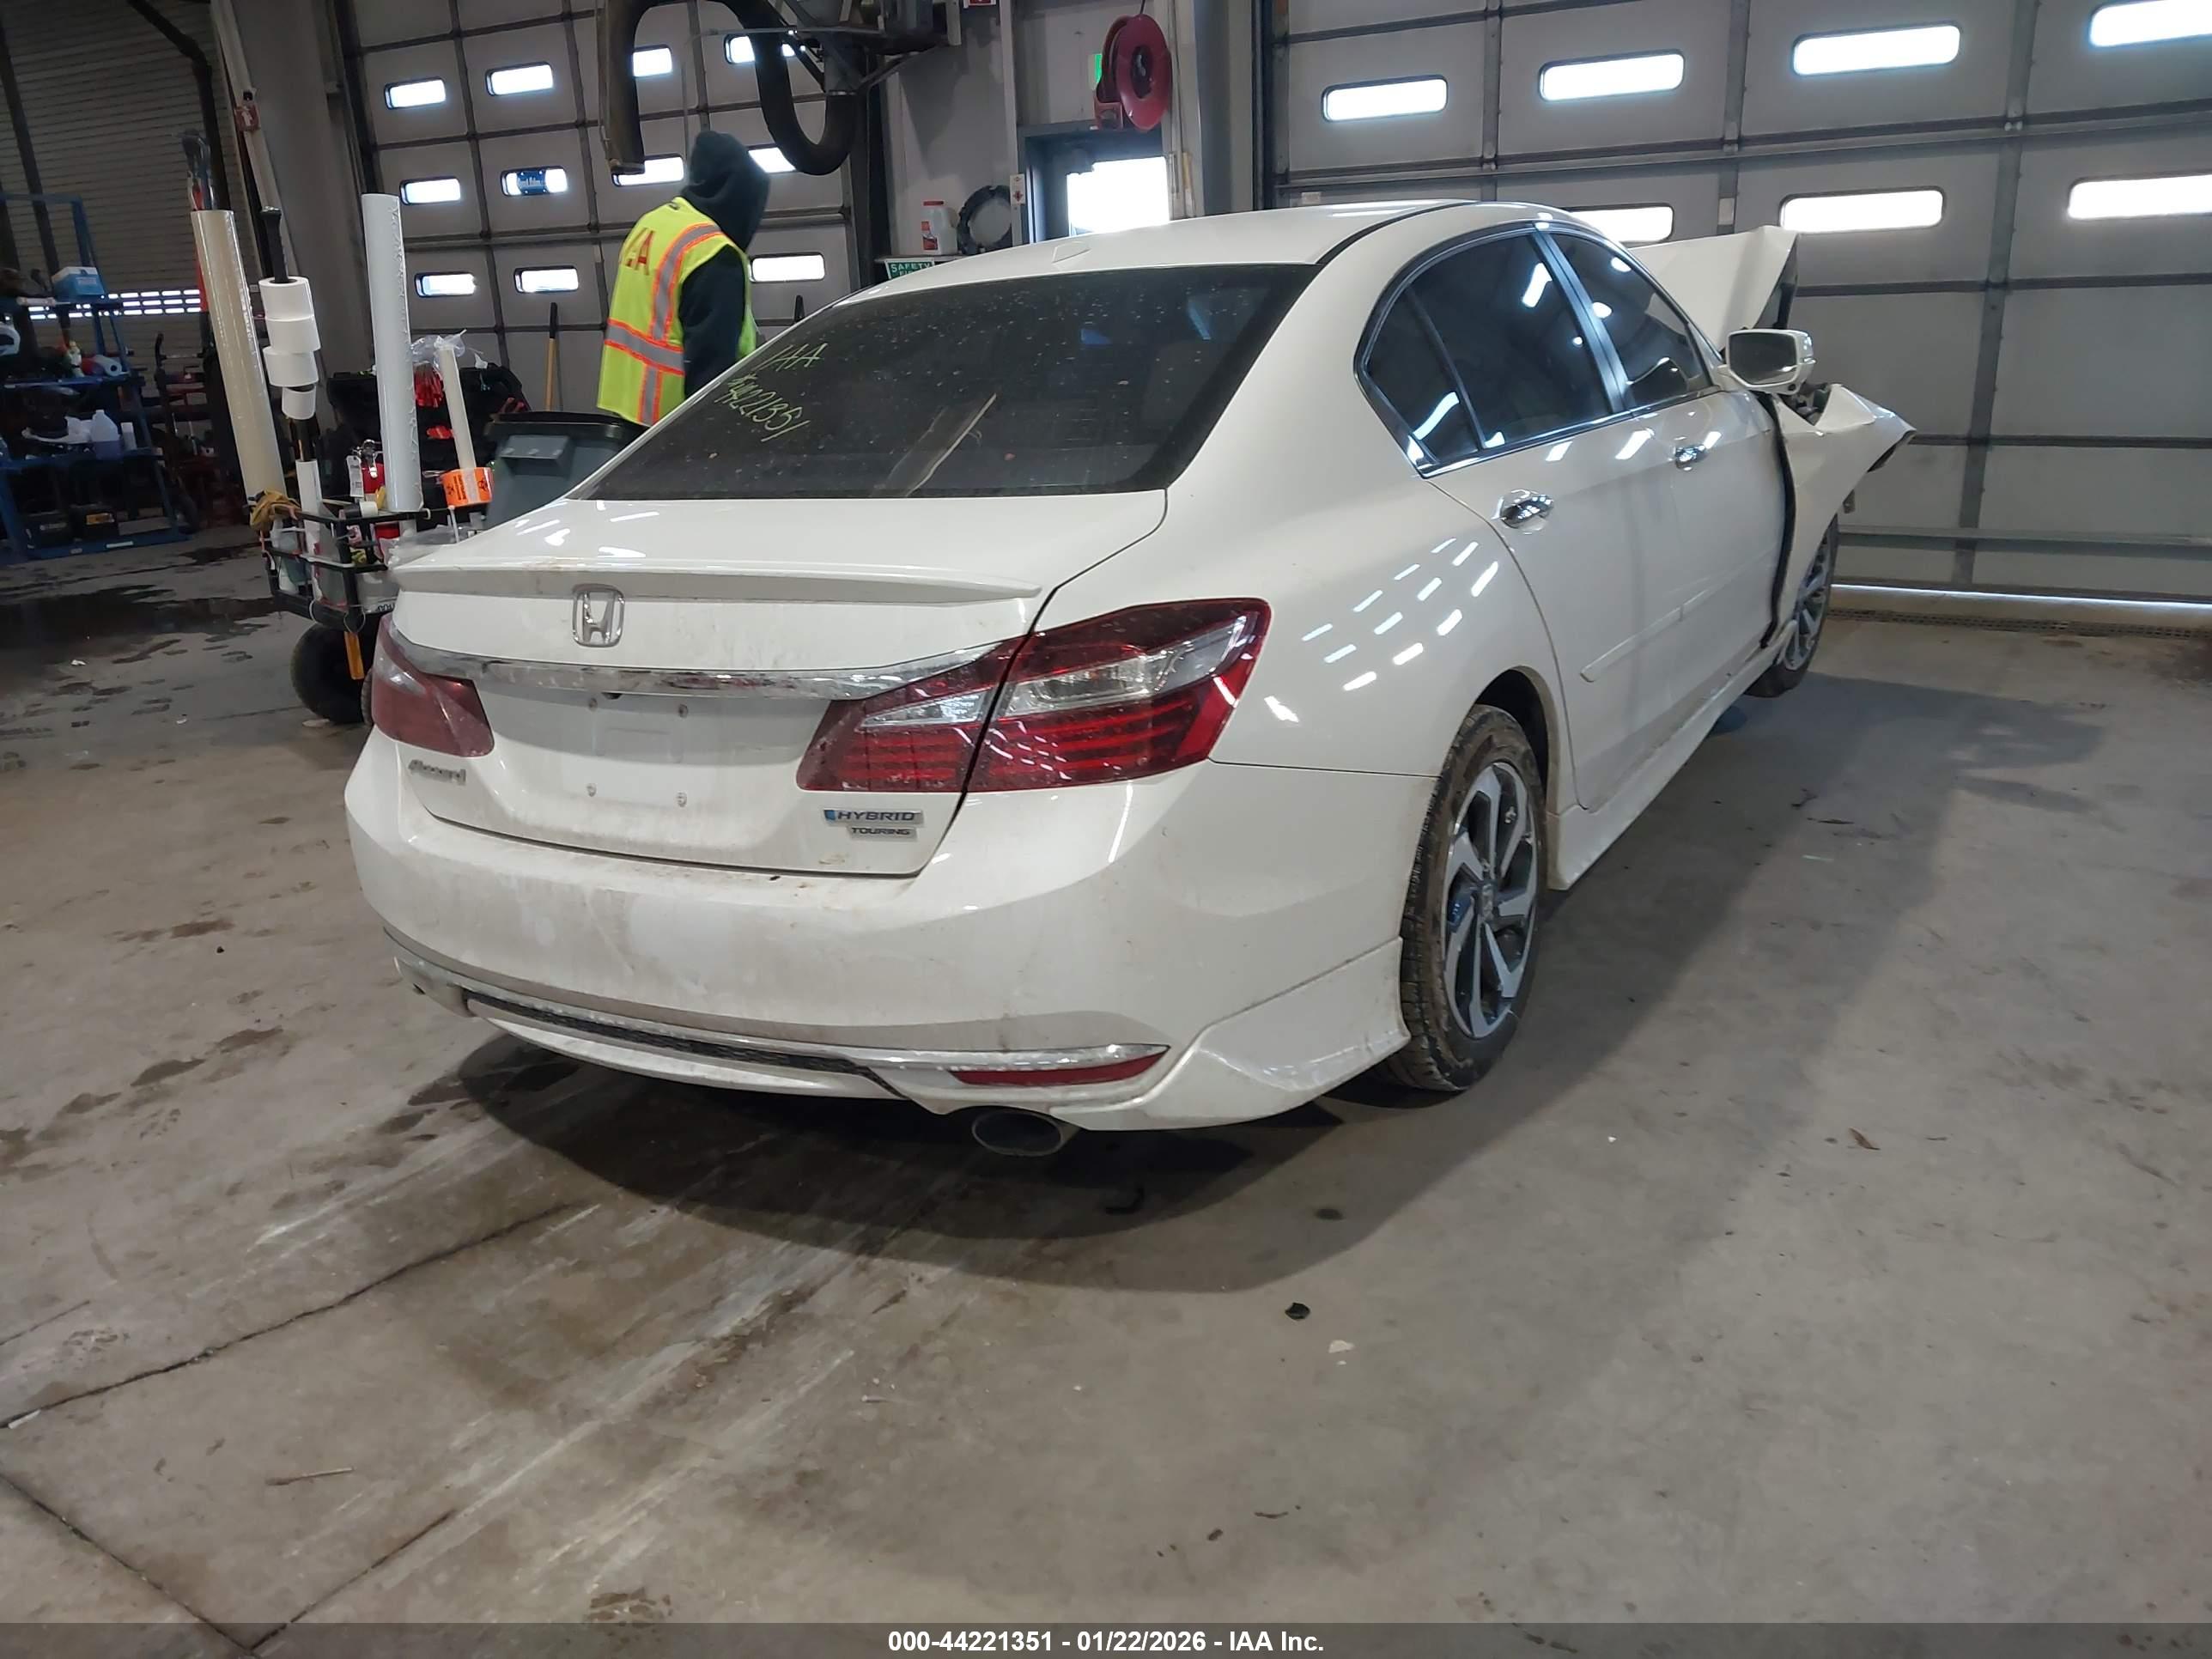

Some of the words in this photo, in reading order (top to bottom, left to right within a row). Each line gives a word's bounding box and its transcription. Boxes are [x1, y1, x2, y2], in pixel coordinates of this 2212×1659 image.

[891, 261, 930, 273] SAFETY
[836, 810, 915, 821] HYBRID
[851, 827, 911, 836] TOURING
